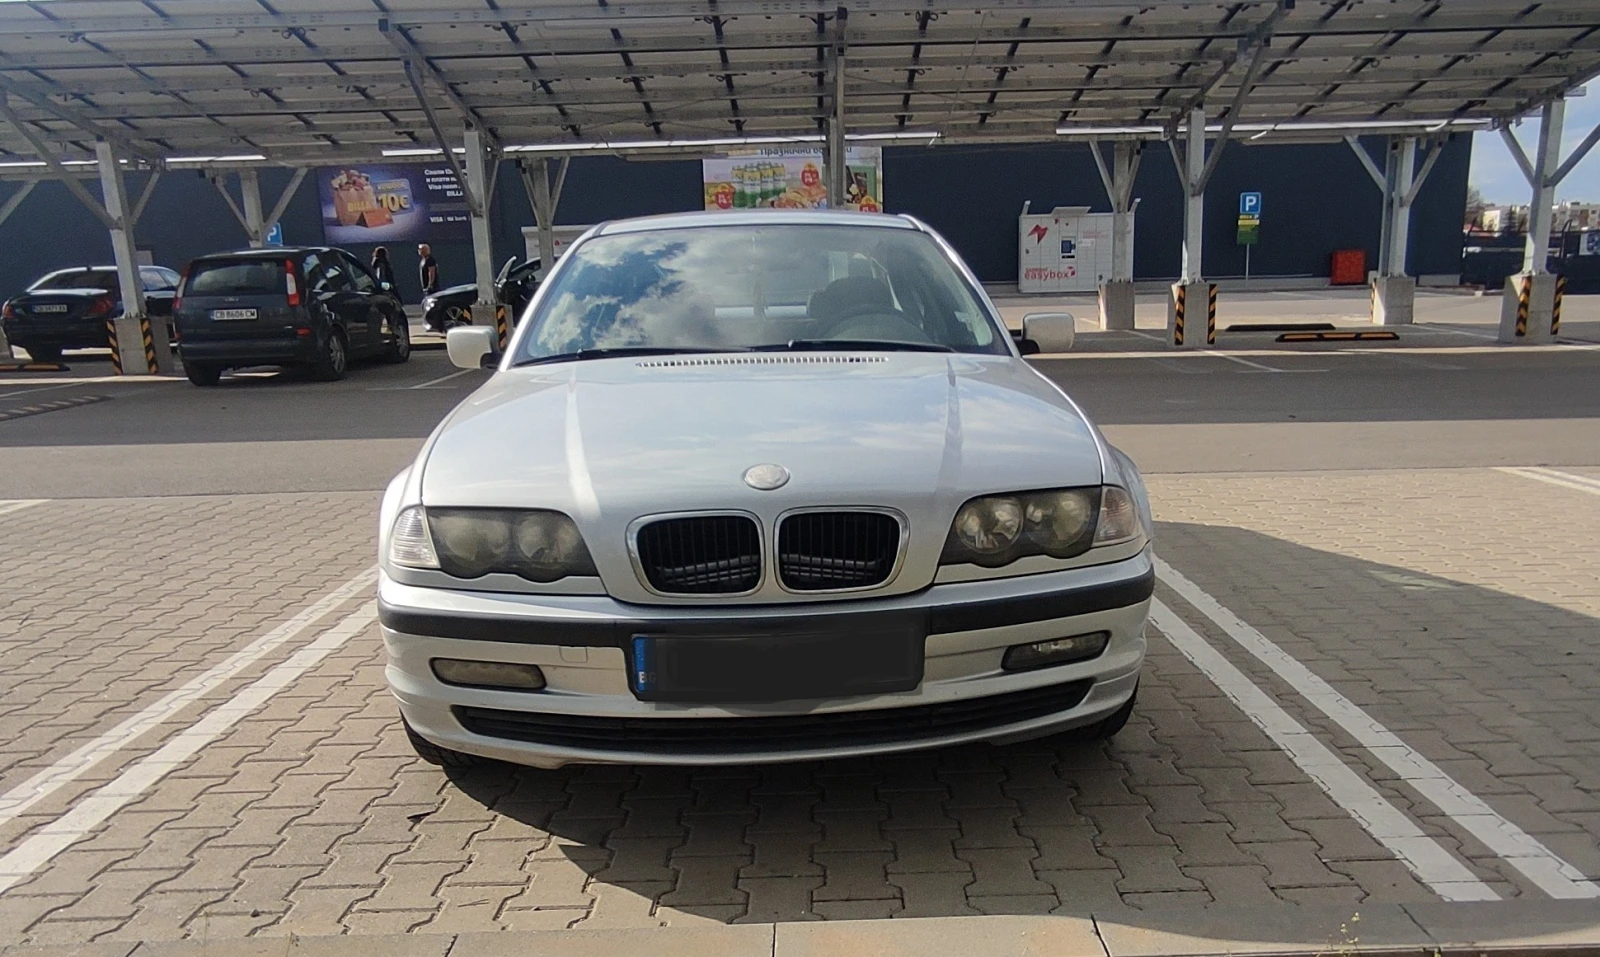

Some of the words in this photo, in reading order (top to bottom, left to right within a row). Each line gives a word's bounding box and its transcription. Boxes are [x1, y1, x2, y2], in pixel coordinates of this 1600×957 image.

[1245, 196, 1257, 211] P
[1024, 268, 1069, 282] easybox
[215, 310, 225, 319] CB
